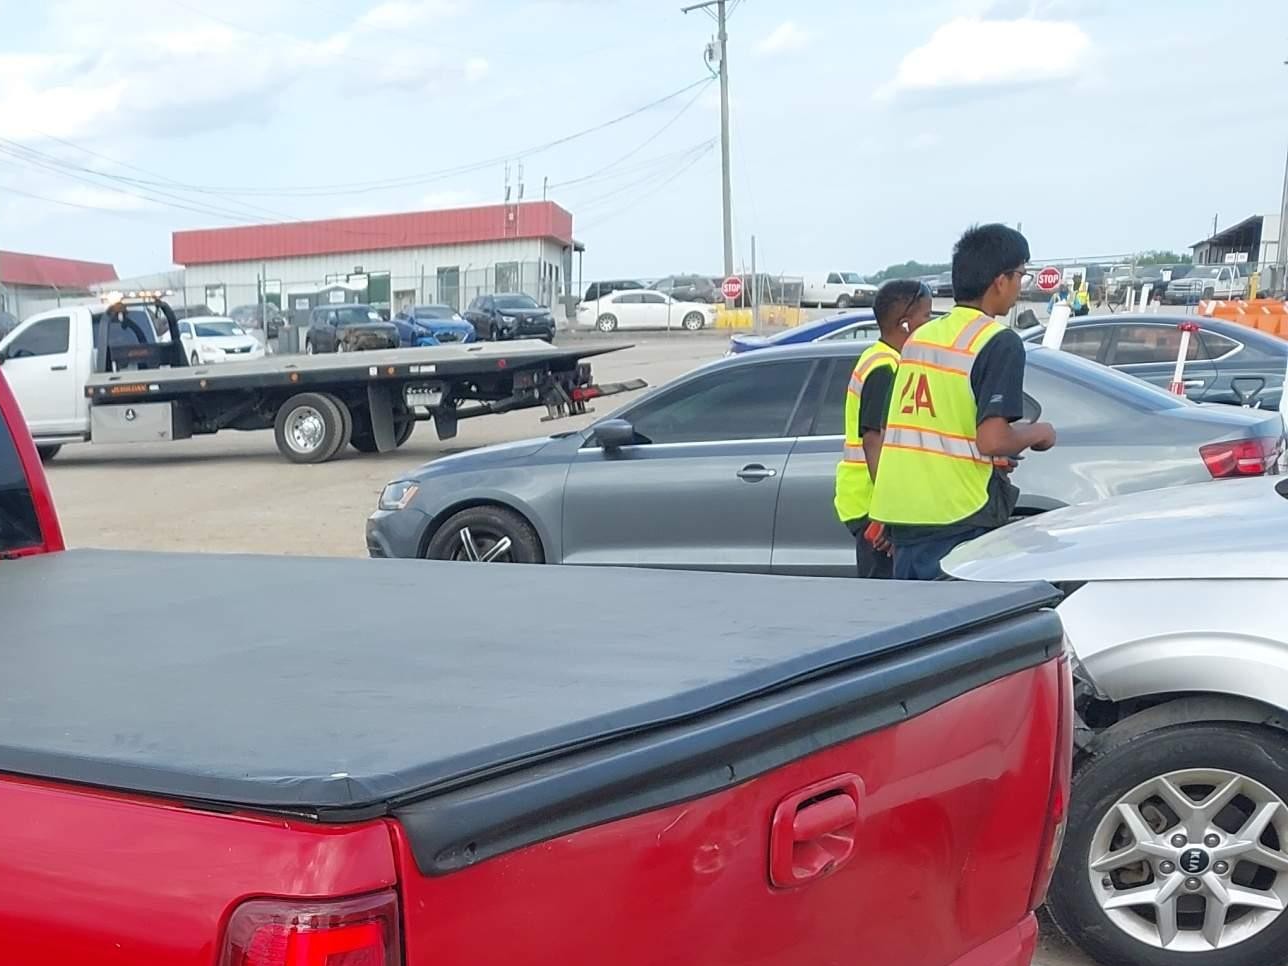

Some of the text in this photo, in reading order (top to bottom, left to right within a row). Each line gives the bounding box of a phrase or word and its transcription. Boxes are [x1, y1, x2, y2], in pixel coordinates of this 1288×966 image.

[1038, 274, 1059, 284] STOP
[723, 283, 741, 292] STOP
[1189, 851, 1201, 871] KIA
